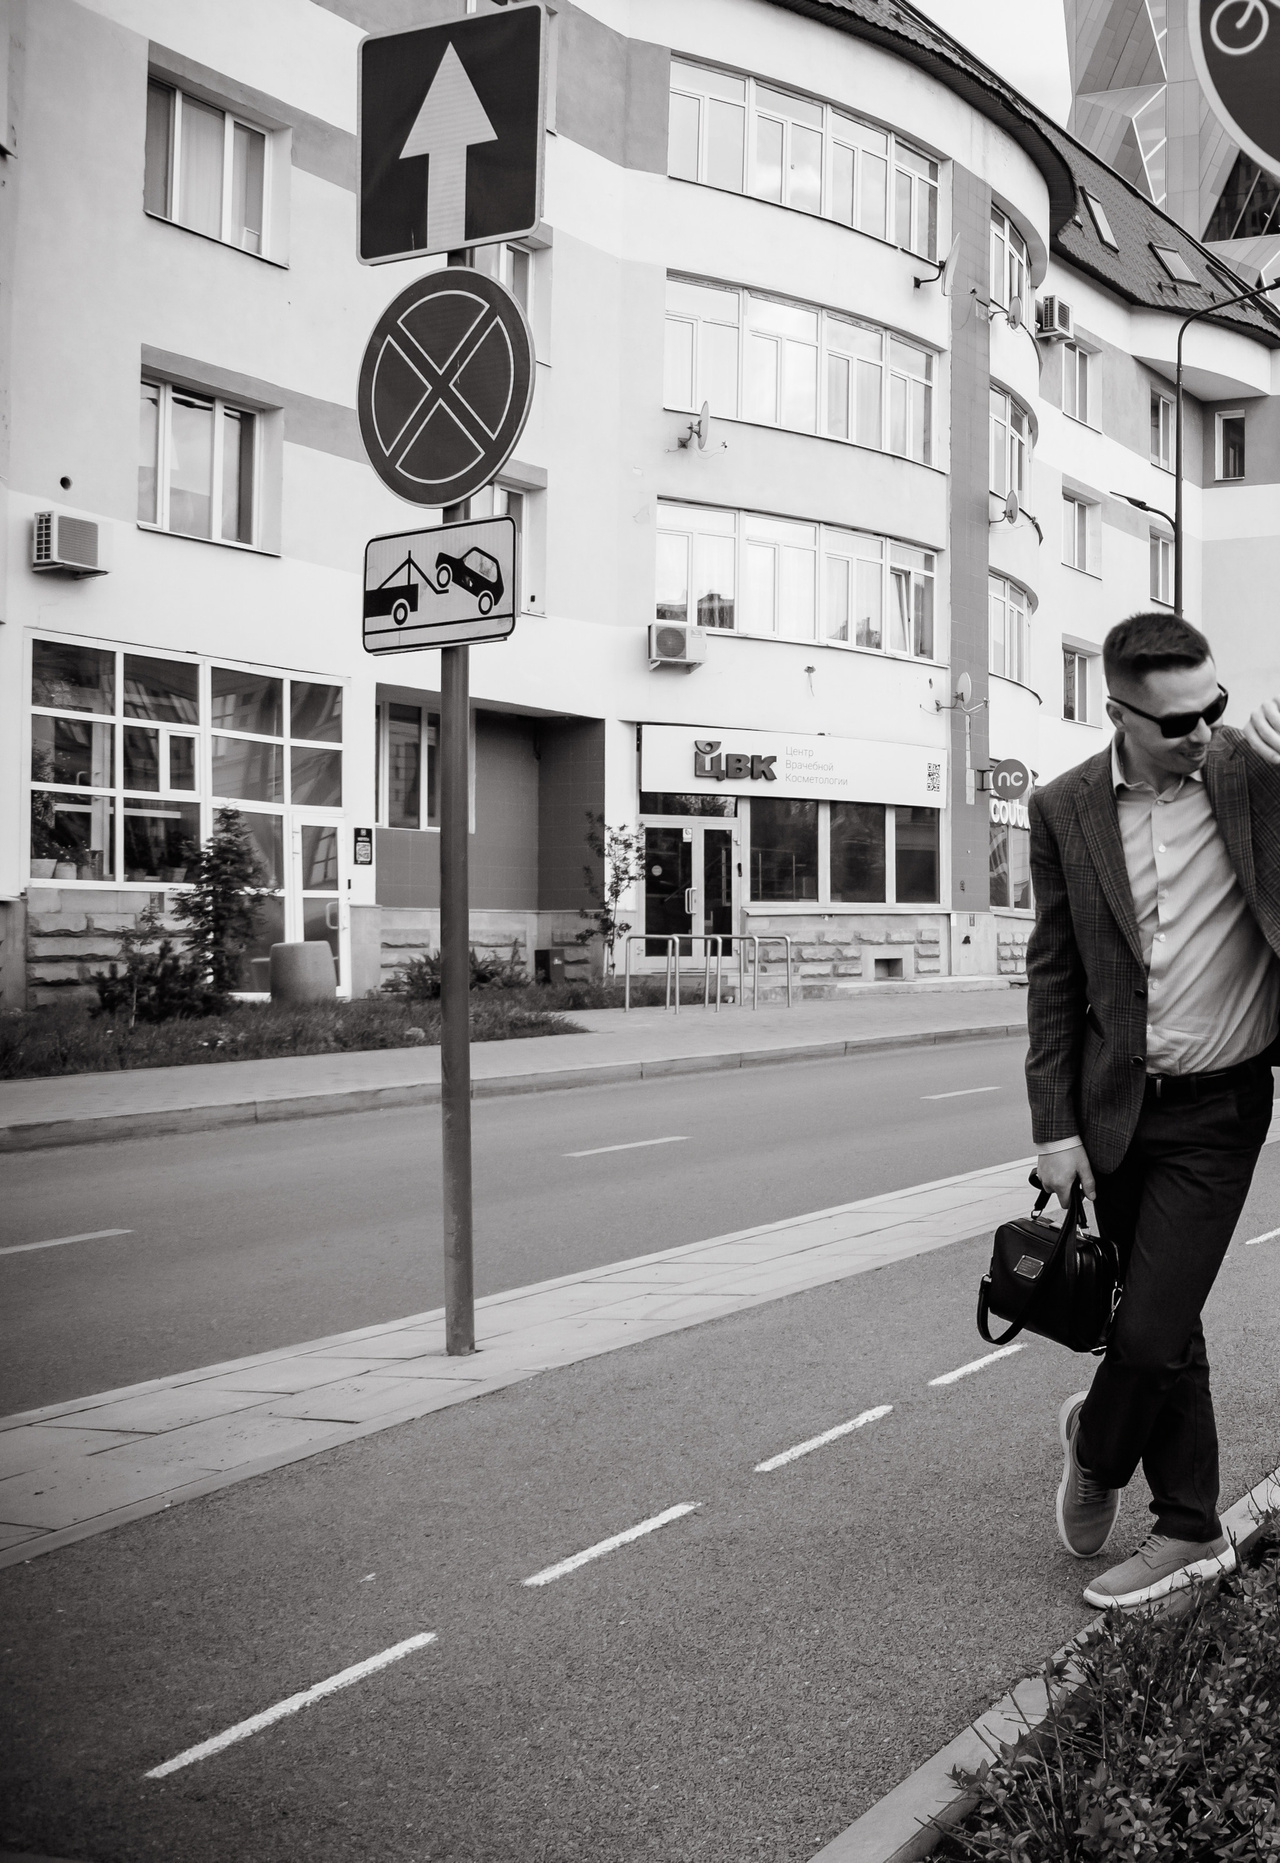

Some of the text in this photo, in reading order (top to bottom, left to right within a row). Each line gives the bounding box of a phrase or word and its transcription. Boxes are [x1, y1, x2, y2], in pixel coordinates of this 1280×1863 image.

[785, 746, 814, 758] Центр
[694, 740, 777, 781] ЦВК
[785, 759, 834, 771] Врачебной
[785, 773, 848, 785] Косметологии
[998, 771, 1023, 787] nc
